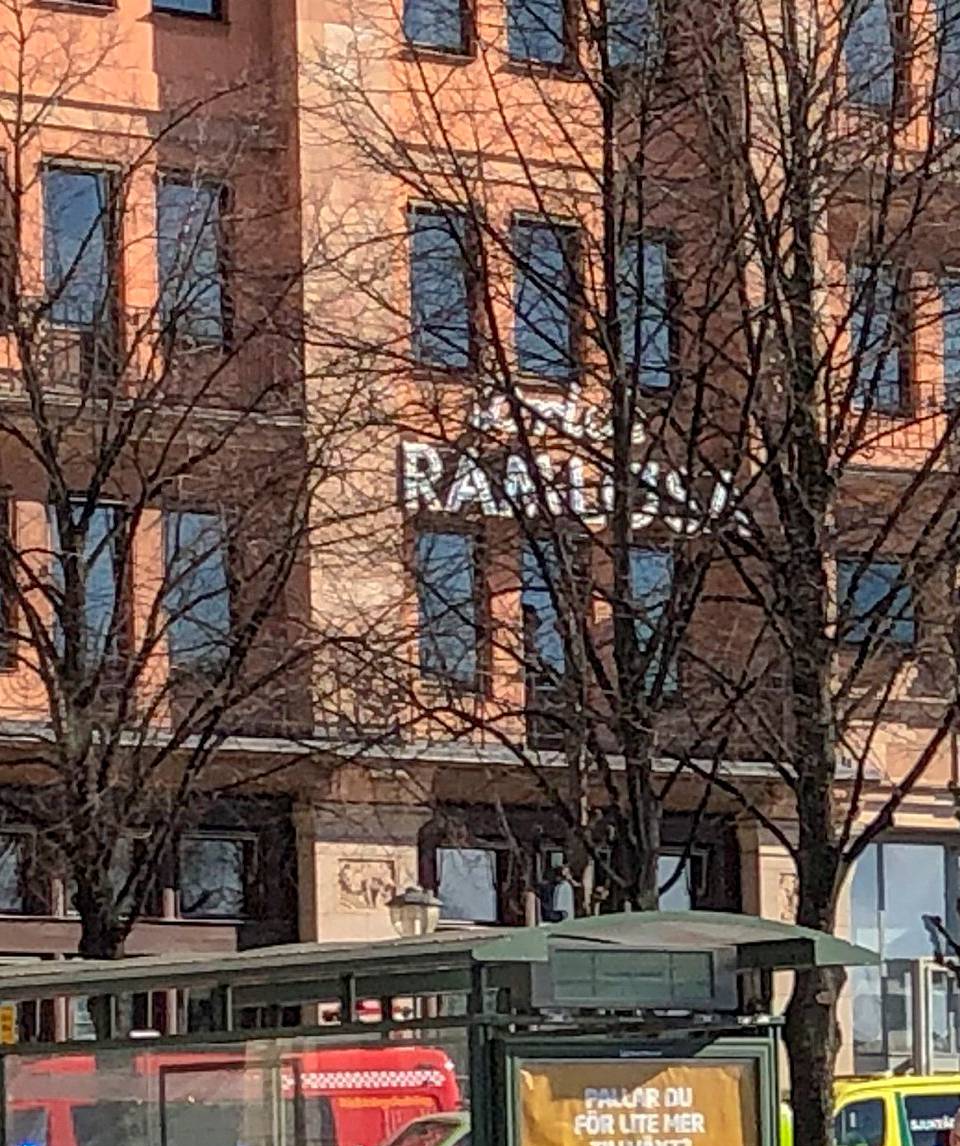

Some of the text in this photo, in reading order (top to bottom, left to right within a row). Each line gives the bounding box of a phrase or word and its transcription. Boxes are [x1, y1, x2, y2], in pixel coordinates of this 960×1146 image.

[584, 1087, 693, 1108] PALLAR DU
[574, 1109, 705, 1135] FÖR LITE MER
